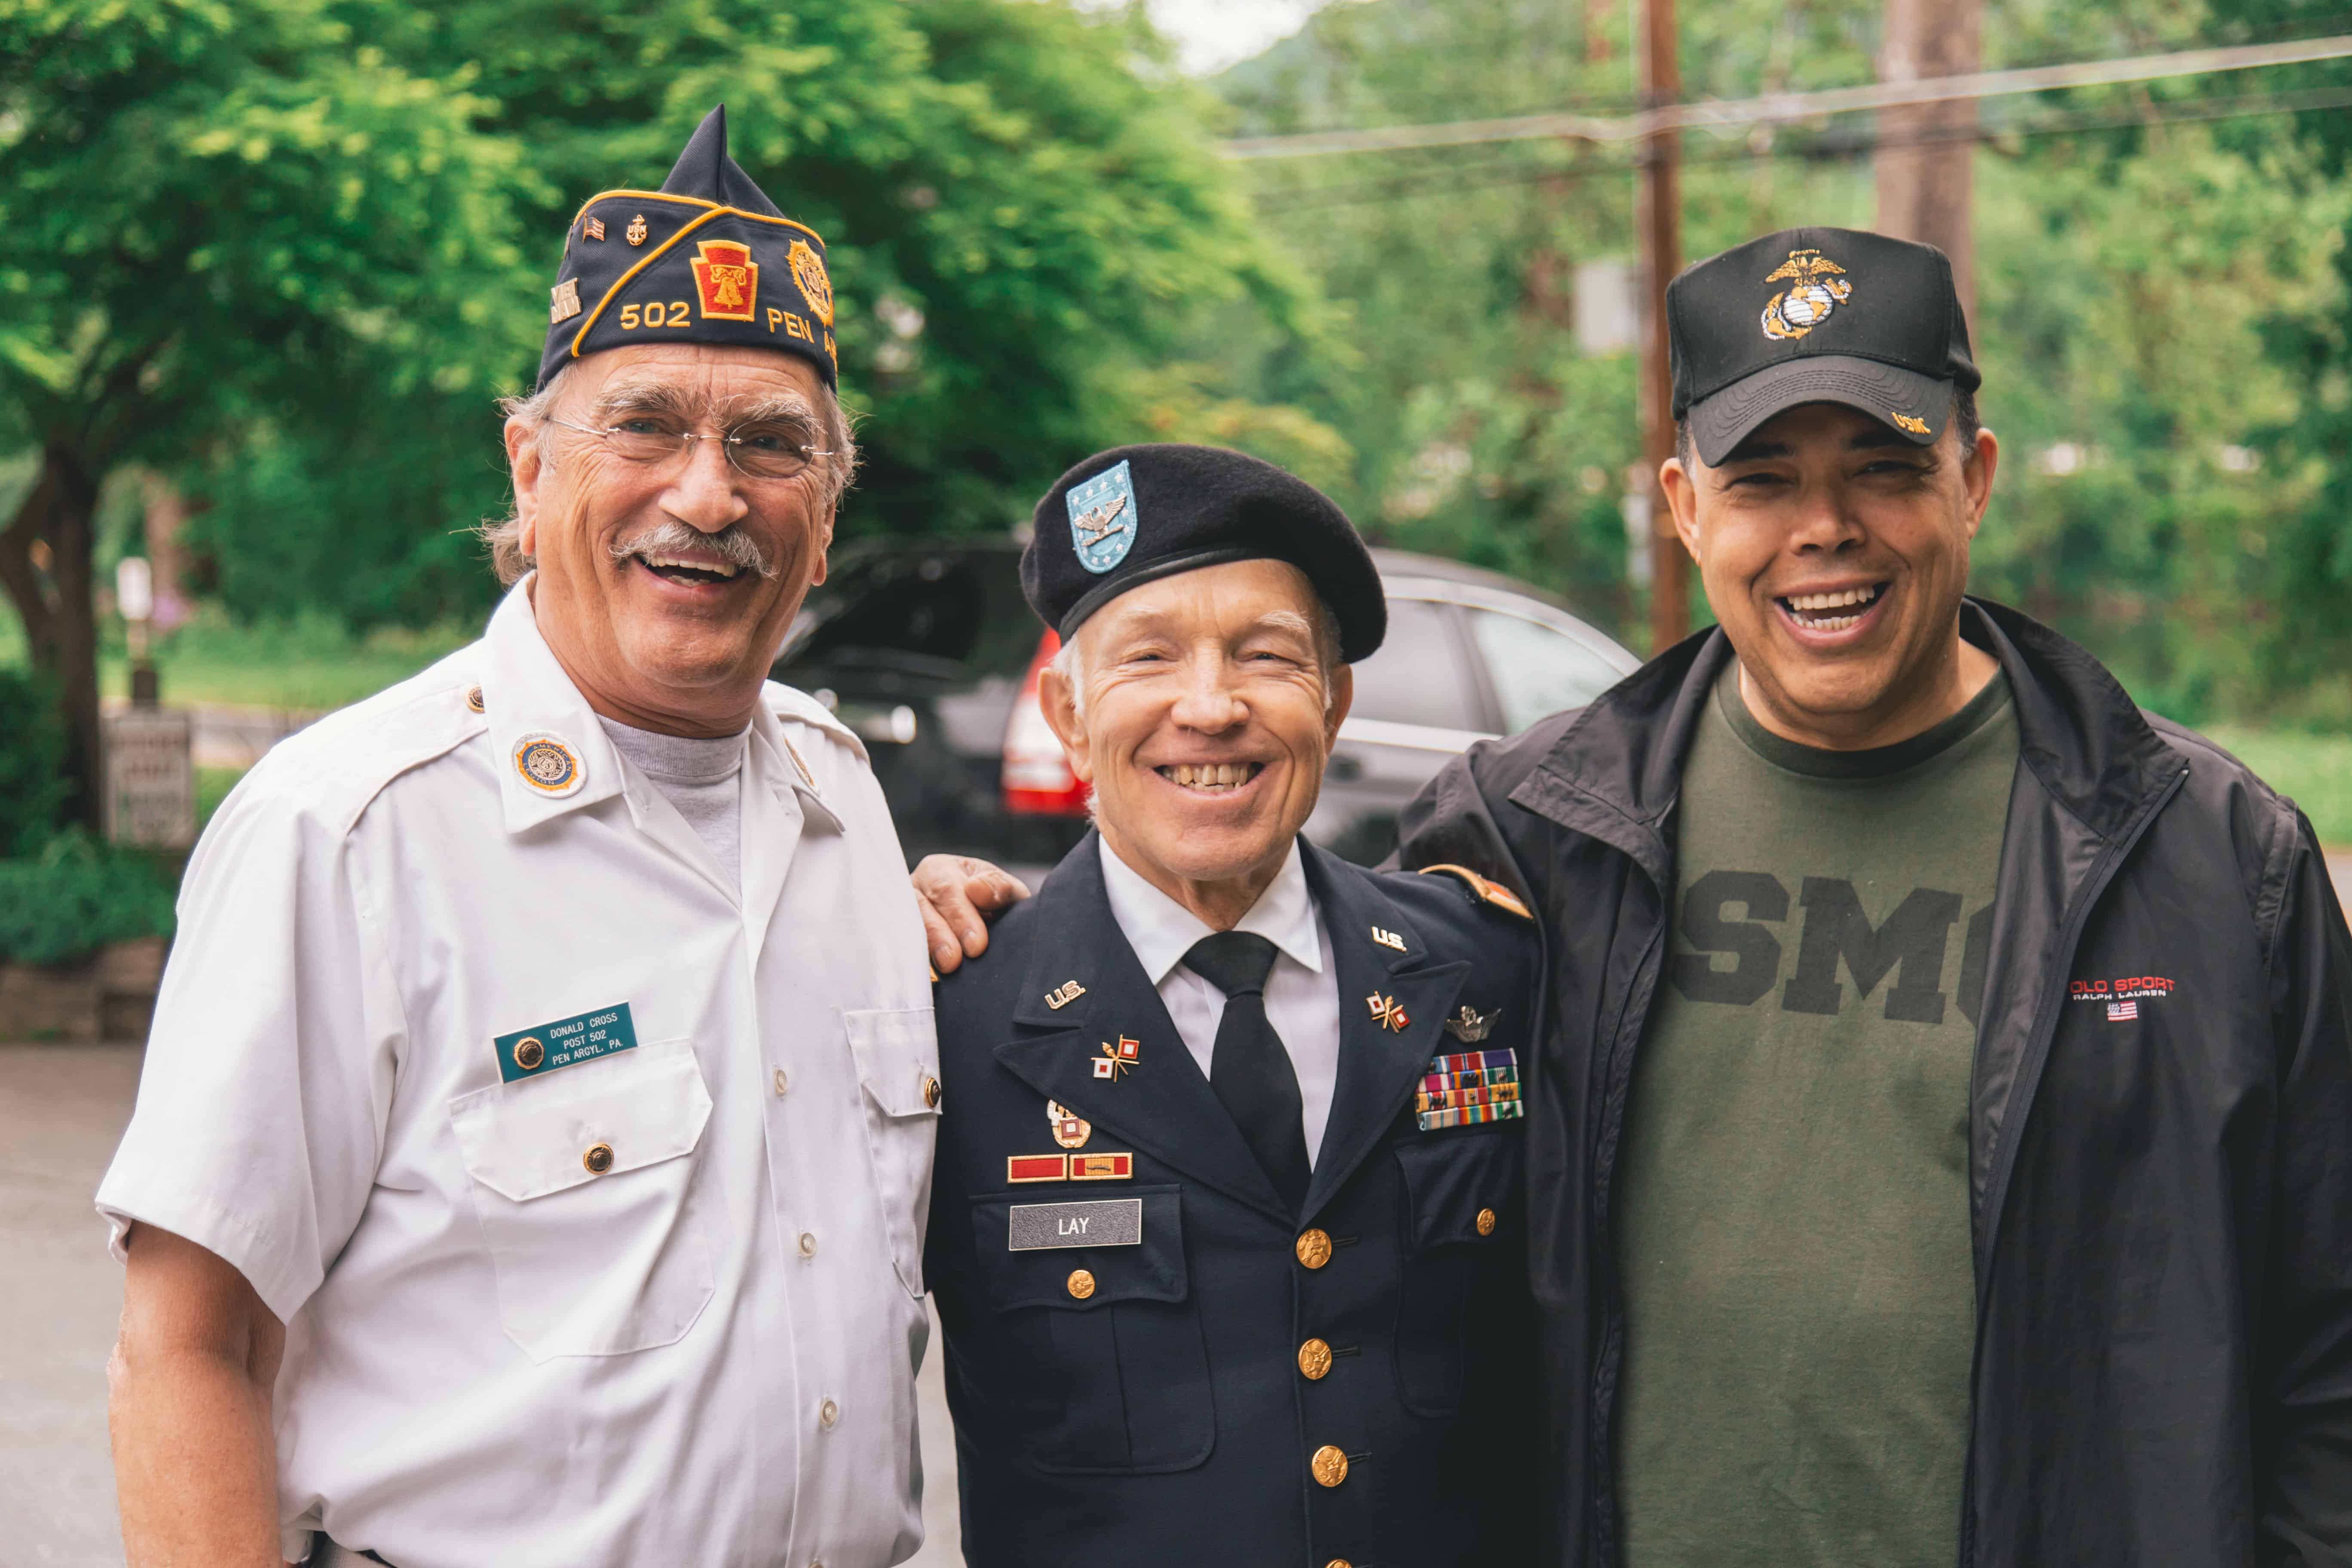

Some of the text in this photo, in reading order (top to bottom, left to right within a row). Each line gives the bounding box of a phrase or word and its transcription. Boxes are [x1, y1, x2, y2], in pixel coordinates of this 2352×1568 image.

[620, 302, 691, 330] 502
[767, 307, 815, 344] PEN
[1892, 412, 1931, 434] USMC
[533, 744, 572, 772] AMERICAN
[523, 763, 554, 785] LEGION
[1668, 869, 1996, 1026] SM
[1044, 980, 1086, 1010] U.S.
[2070, 976, 2175, 993] OLO SPORT
[2118, 989, 2166, 999] LAUREN
[550, 1013, 618, 1039] DONALD CROSS
[564, 1030, 607, 1049] POST 502
[552, 1052, 570, 1066] PEN
[609, 1038, 624, 1049] PA.
[1059, 1217, 1090, 1235] LAY
